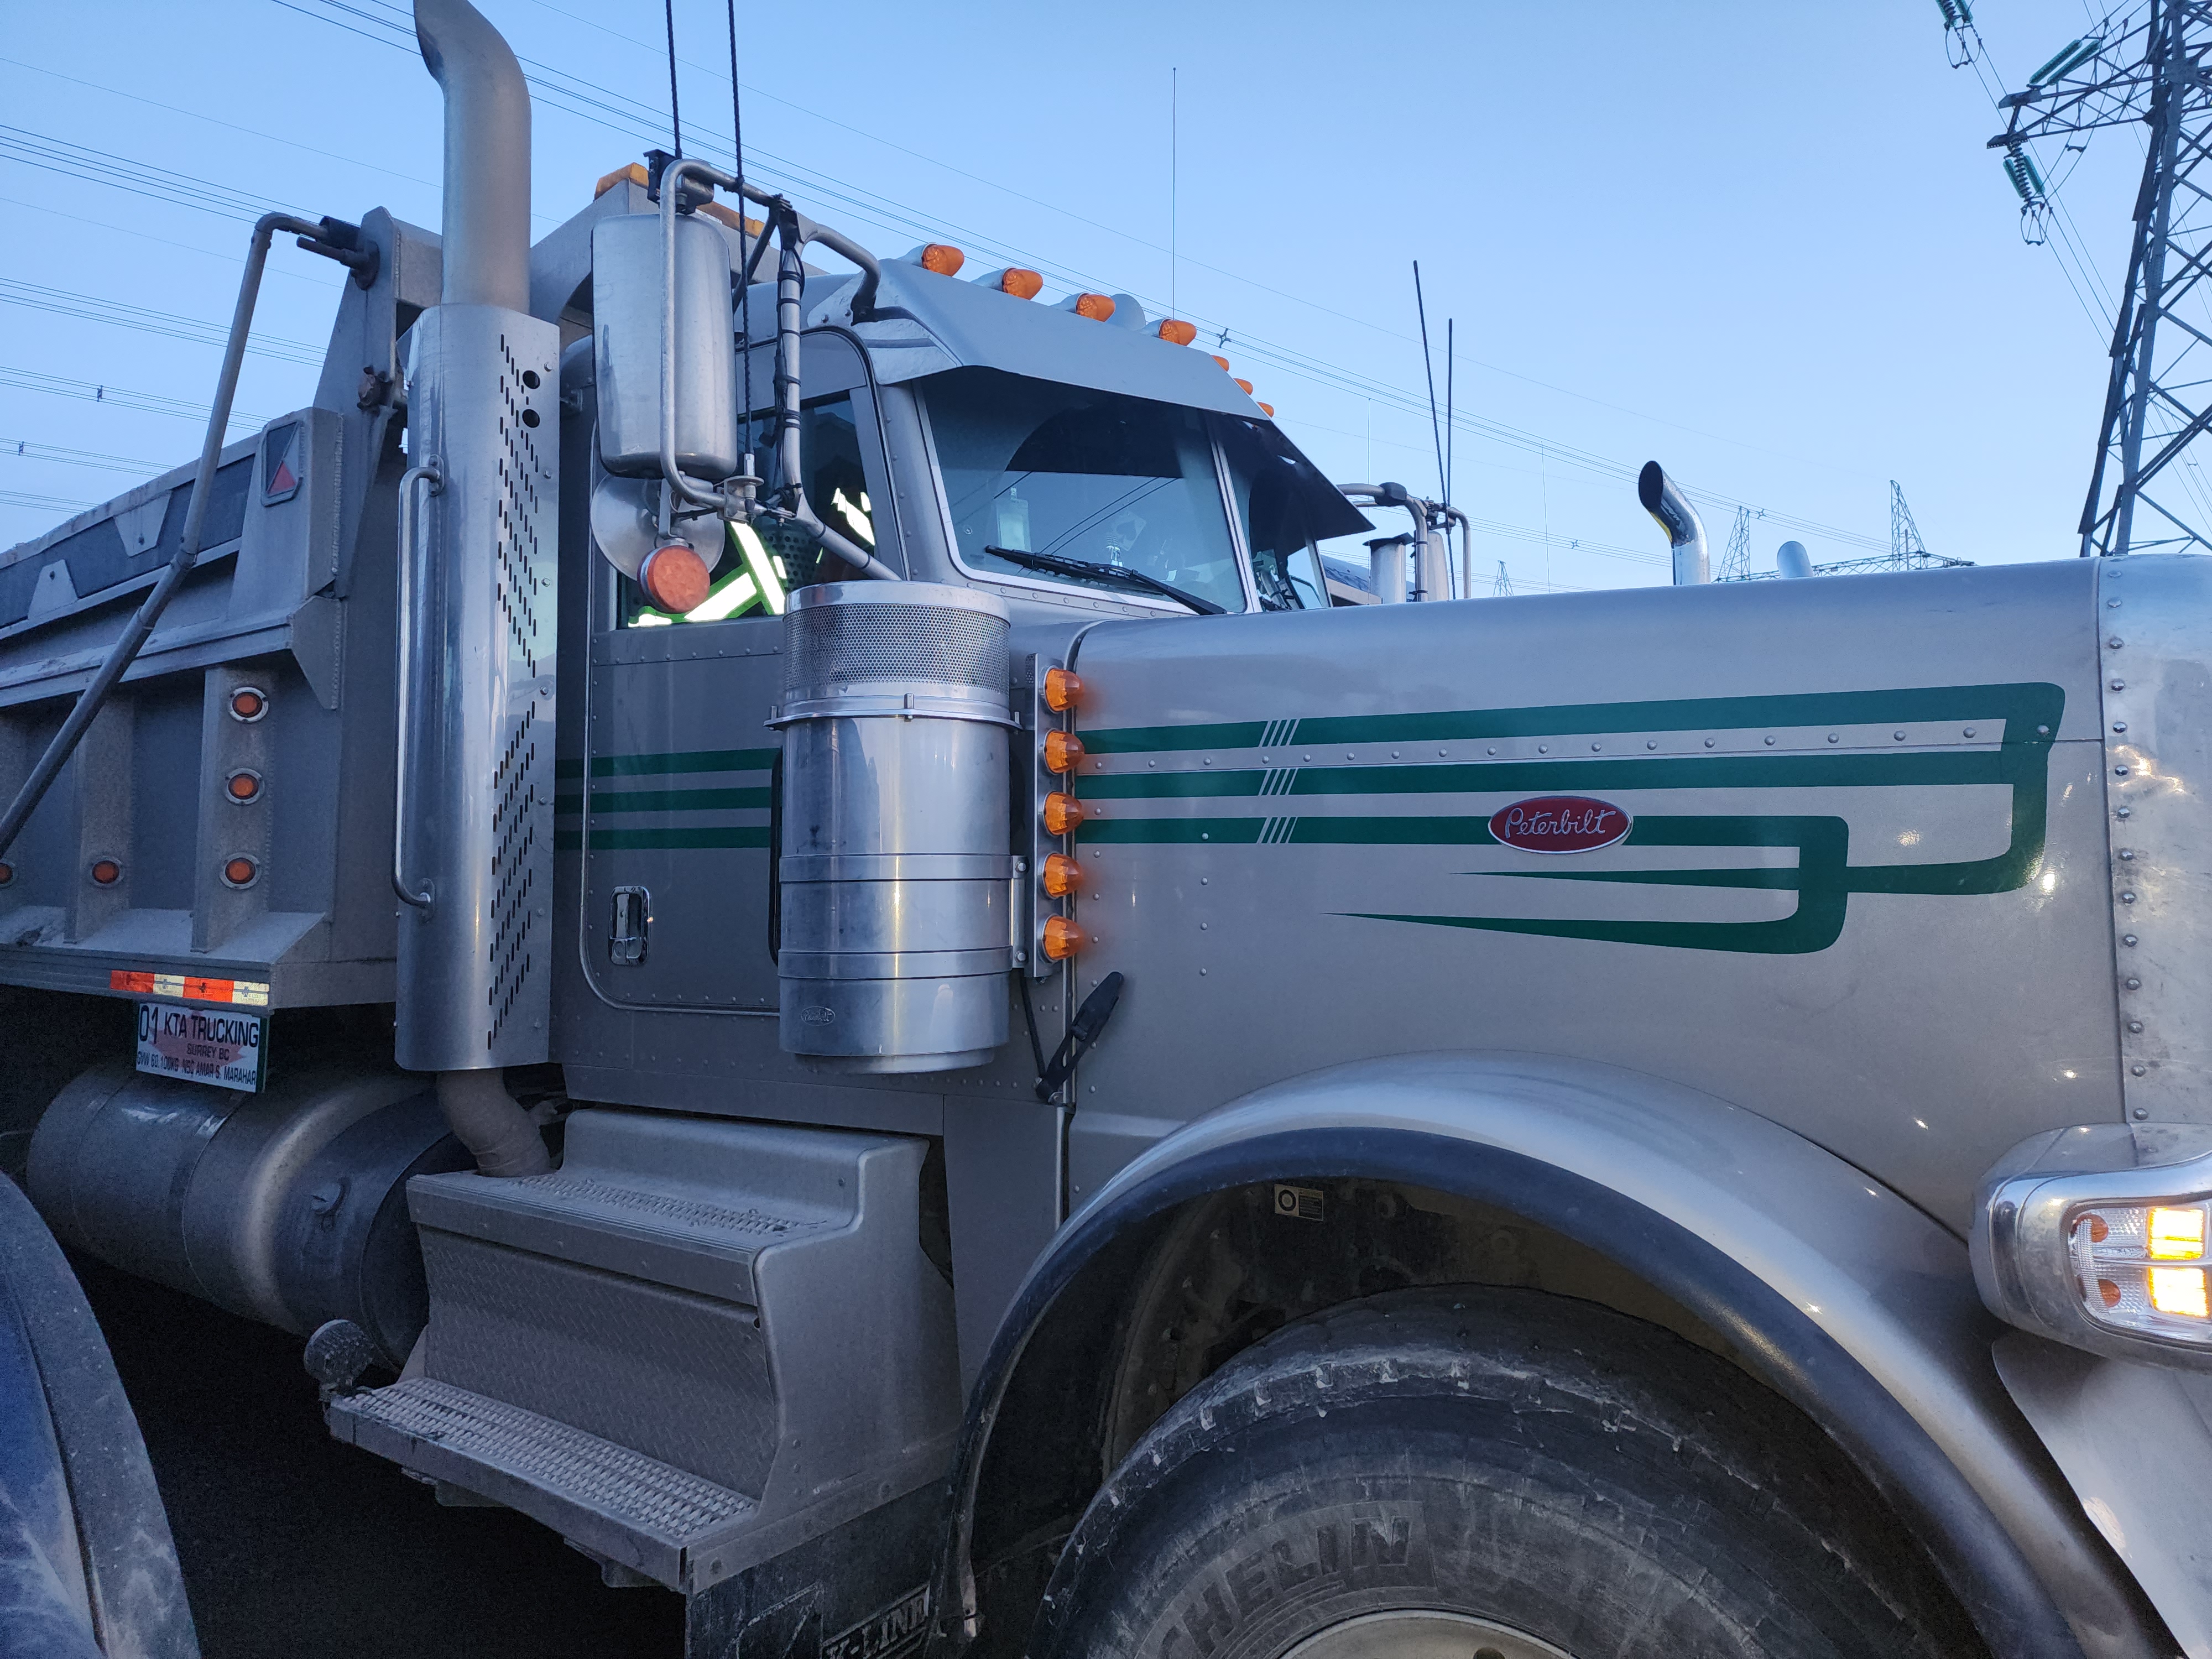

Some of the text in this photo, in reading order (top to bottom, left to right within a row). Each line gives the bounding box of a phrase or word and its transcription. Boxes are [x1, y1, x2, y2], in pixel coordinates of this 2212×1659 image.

[1505, 807, 1616, 839] Peterbilt
[139, 1005, 259, 1048] 01 KTA TRUCKING
[187, 1043, 230, 1061] SURREY BC
[196, 1061, 213, 1078] AMAR
[224, 1066, 256, 1086] MARAHAR
